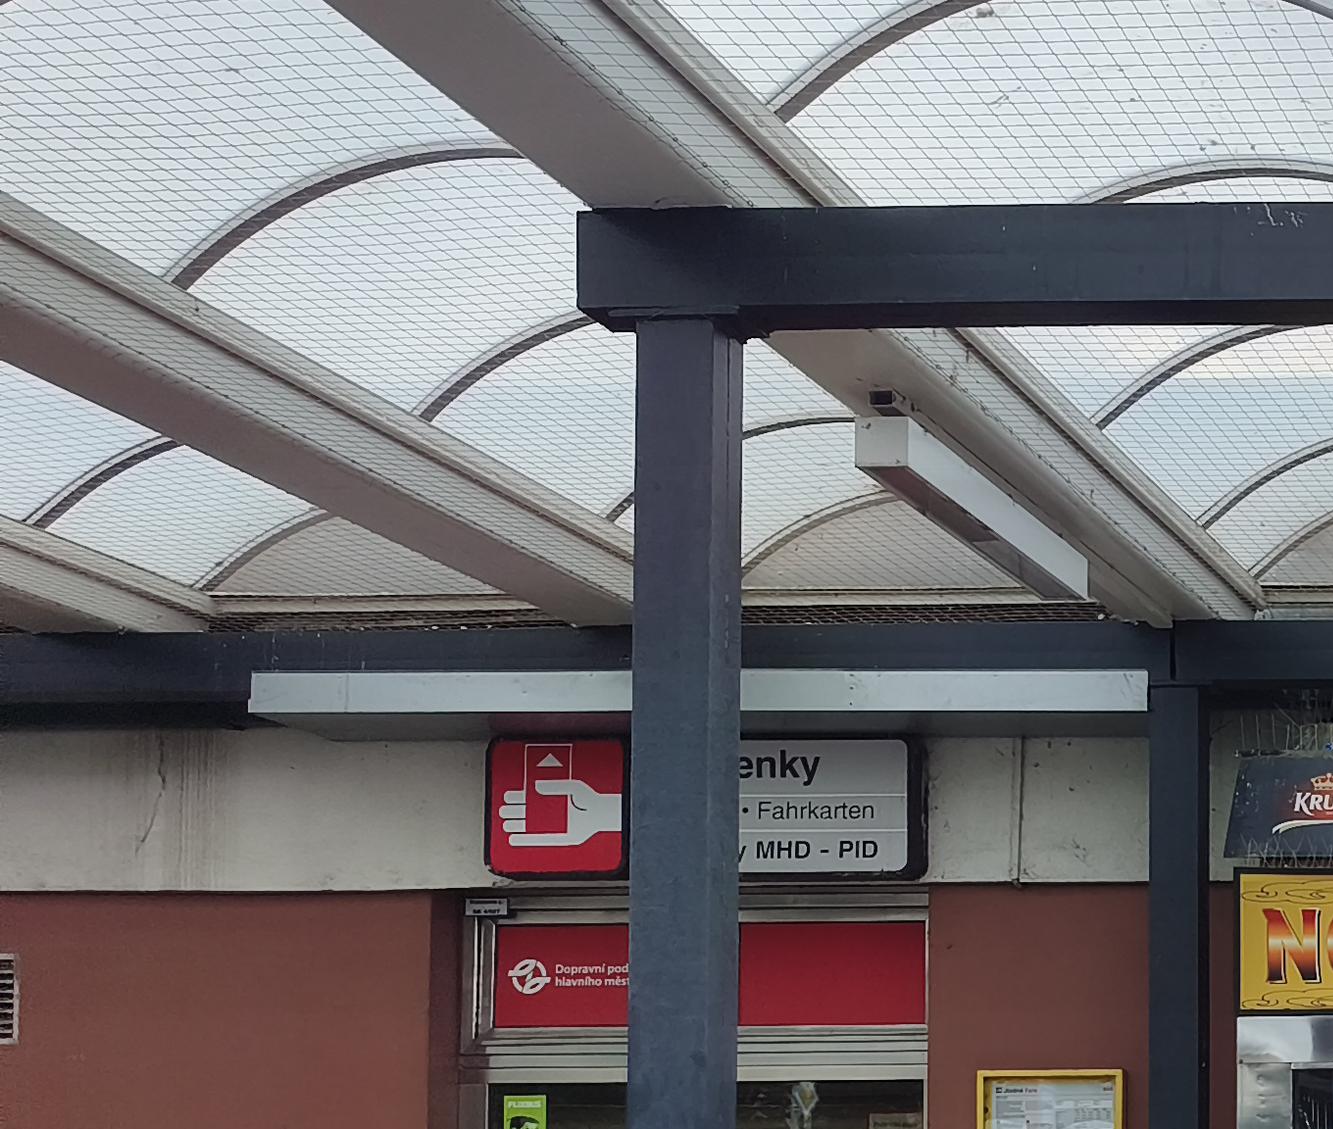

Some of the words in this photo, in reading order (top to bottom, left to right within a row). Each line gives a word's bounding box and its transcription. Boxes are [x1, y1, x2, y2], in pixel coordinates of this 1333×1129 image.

[739, 749, 821, 787] enky
[758, 801, 875, 820] Fahrkarten
[756, 840, 811, 859] MHD
[838, 840, 879, 859] PID
[555, 963, 606, 976] Dopravní
[607, 963, 630, 976] pod
[555, 976, 603, 988] hlavního
[604, 976, 630, 987] měst
